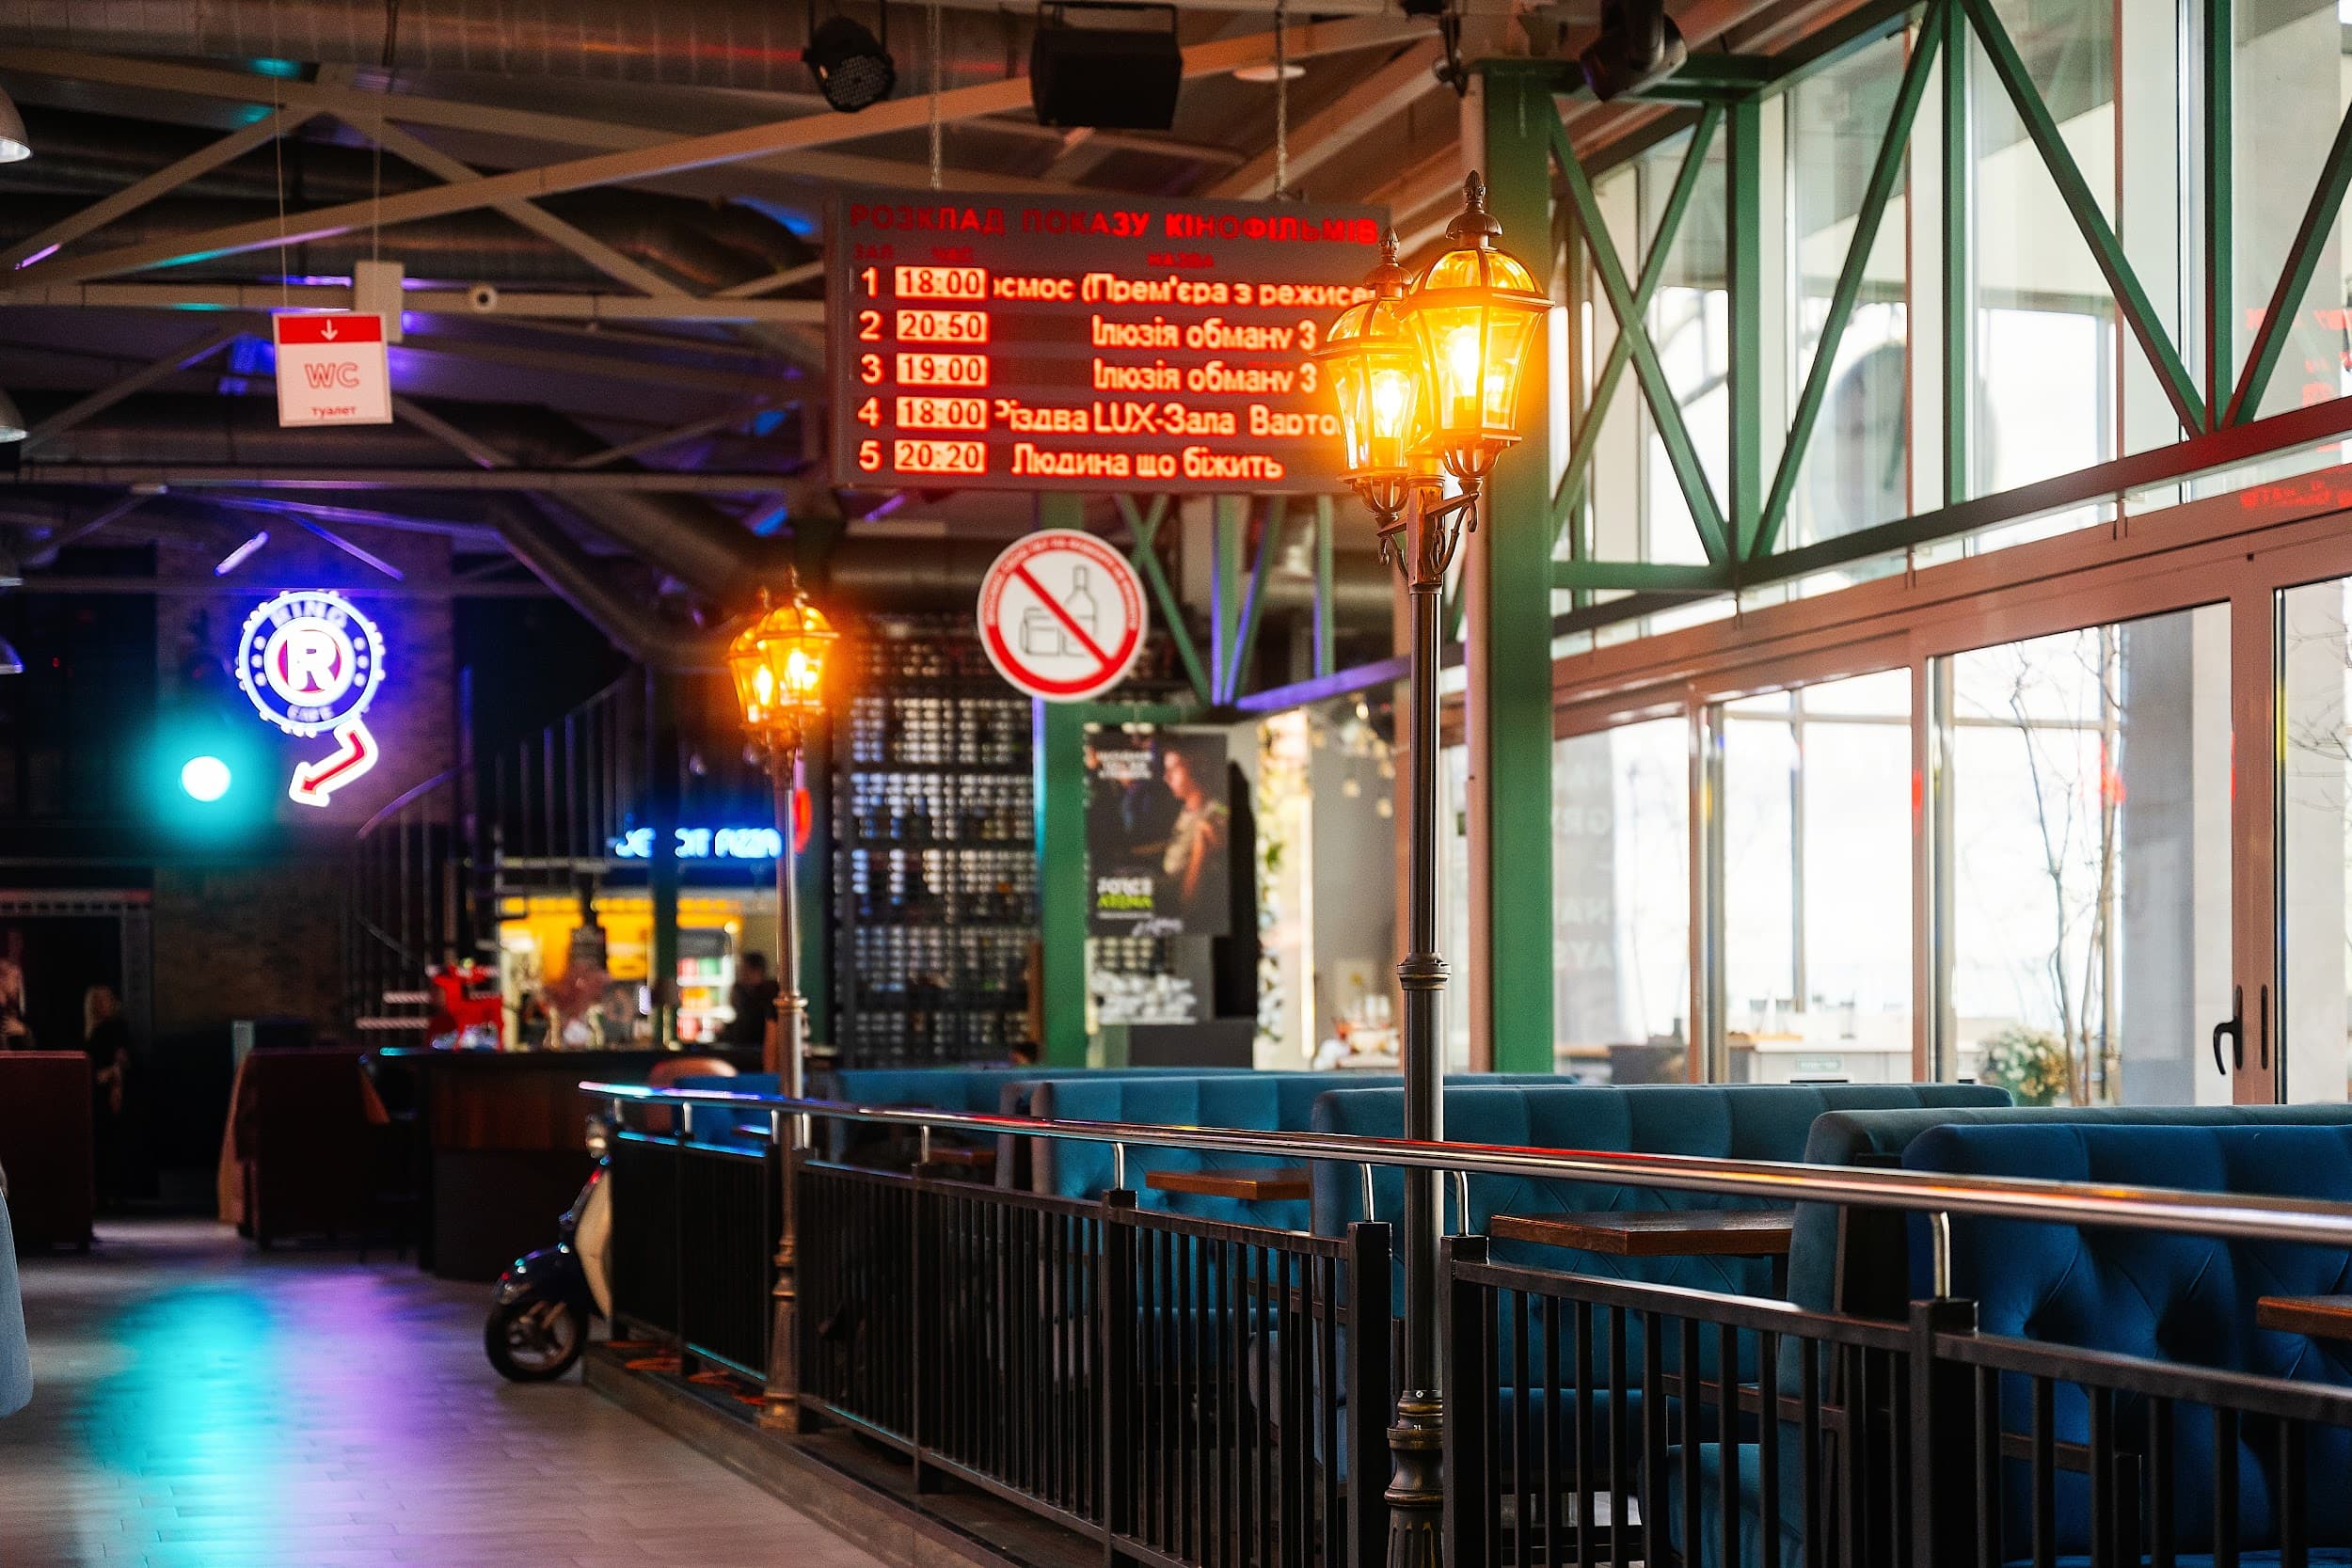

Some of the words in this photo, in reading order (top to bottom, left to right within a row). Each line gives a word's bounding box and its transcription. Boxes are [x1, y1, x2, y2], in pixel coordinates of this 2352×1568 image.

[850, 203, 1006, 236] РОЗКЛАД
[1023, 208, 1151, 238] ПОКАЗУ
[1165, 213, 1379, 245] КІНОФІЛЬМІВ
[861, 266, 879, 299] 1
[898, 268, 982, 296] 18:00
[1259, 283, 1375, 309] режисе
[858, 309, 883, 341] 2
[899, 312, 983, 340] 20:50
[1091, 314, 1179, 348] Ілюзія
[1185, 317, 1295, 351] обману
[1297, 319, 1317, 351] 3
[304, 362, 360, 389] WC
[860, 353, 883, 385] 3
[899, 355, 983, 383] 19:00
[1093, 357, 1180, 390] Ілюзія
[1186, 359, 1295, 393] обману
[1298, 361, 1318, 392] 3
[310, 405, 358, 419] туалет
[857, 396, 882, 429] 4
[899, 398, 983, 426] 18:00
[1091, 401, 1237, 436] LUX-Зала
[858, 439, 883, 472] 5
[898, 442, 982, 469] 20:20
[1011, 442, 1131, 478] Людина
[1183, 445, 1285, 481] біжить
[284, 628, 340, 693] R
